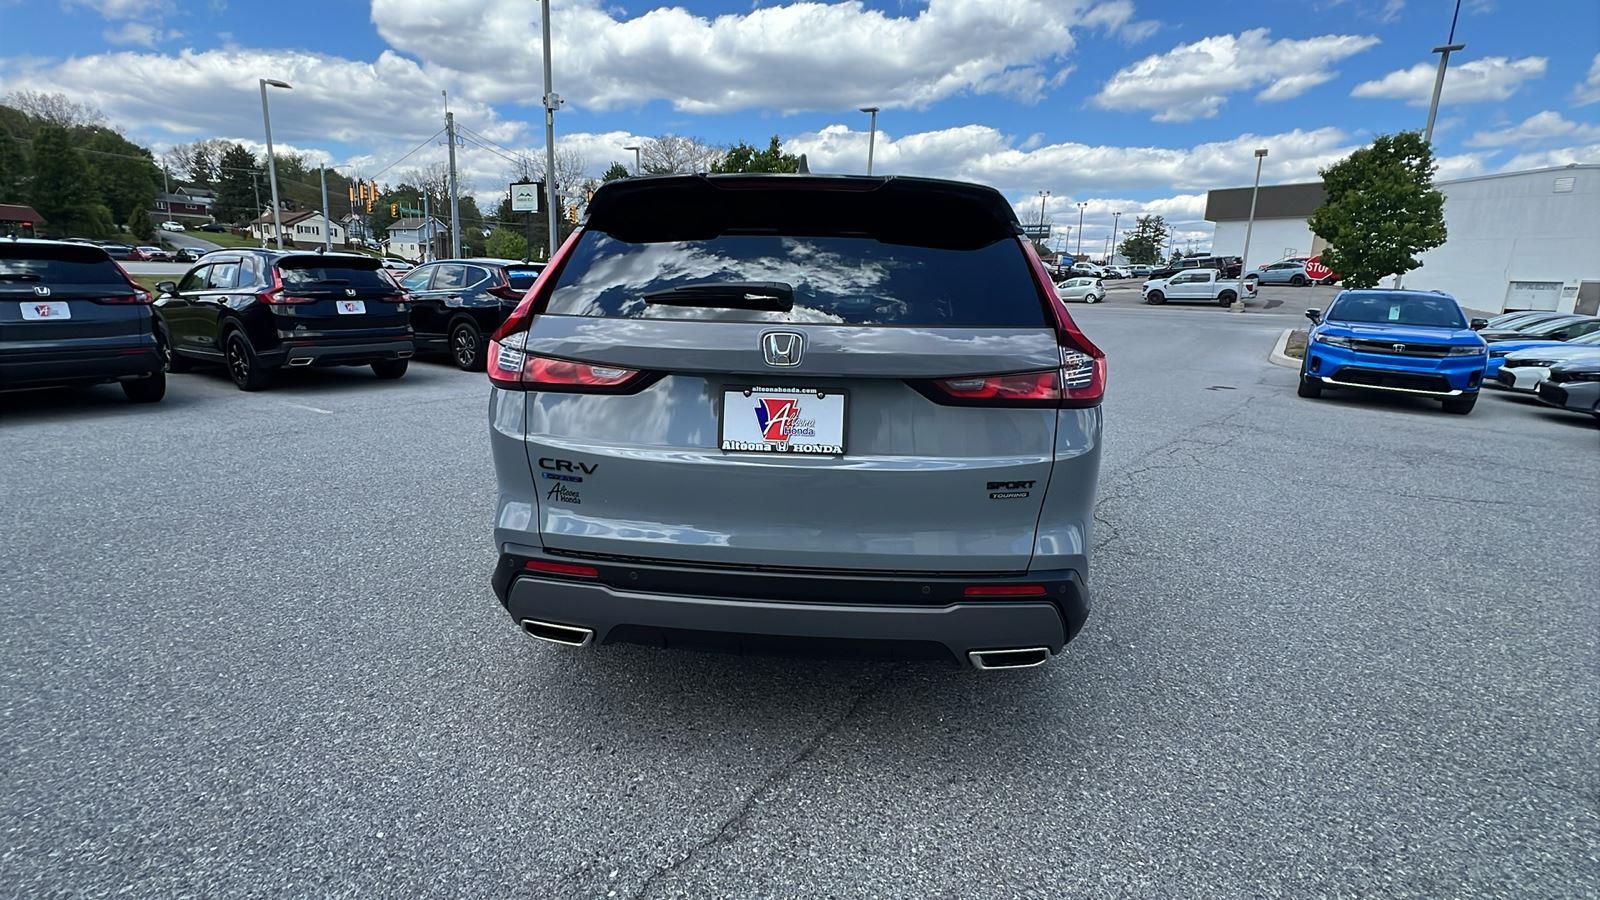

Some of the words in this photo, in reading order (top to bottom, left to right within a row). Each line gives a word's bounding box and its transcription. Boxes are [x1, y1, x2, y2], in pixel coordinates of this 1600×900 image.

[752, 386, 818, 394] altoonahonda.com
[784, 427, 815, 437] Honda
[721, 440, 772, 452] Altoona
[792, 444, 843, 454] HONDA
[538, 457, 599, 475] CR-V
[986, 480, 1037, 490] SPORT
